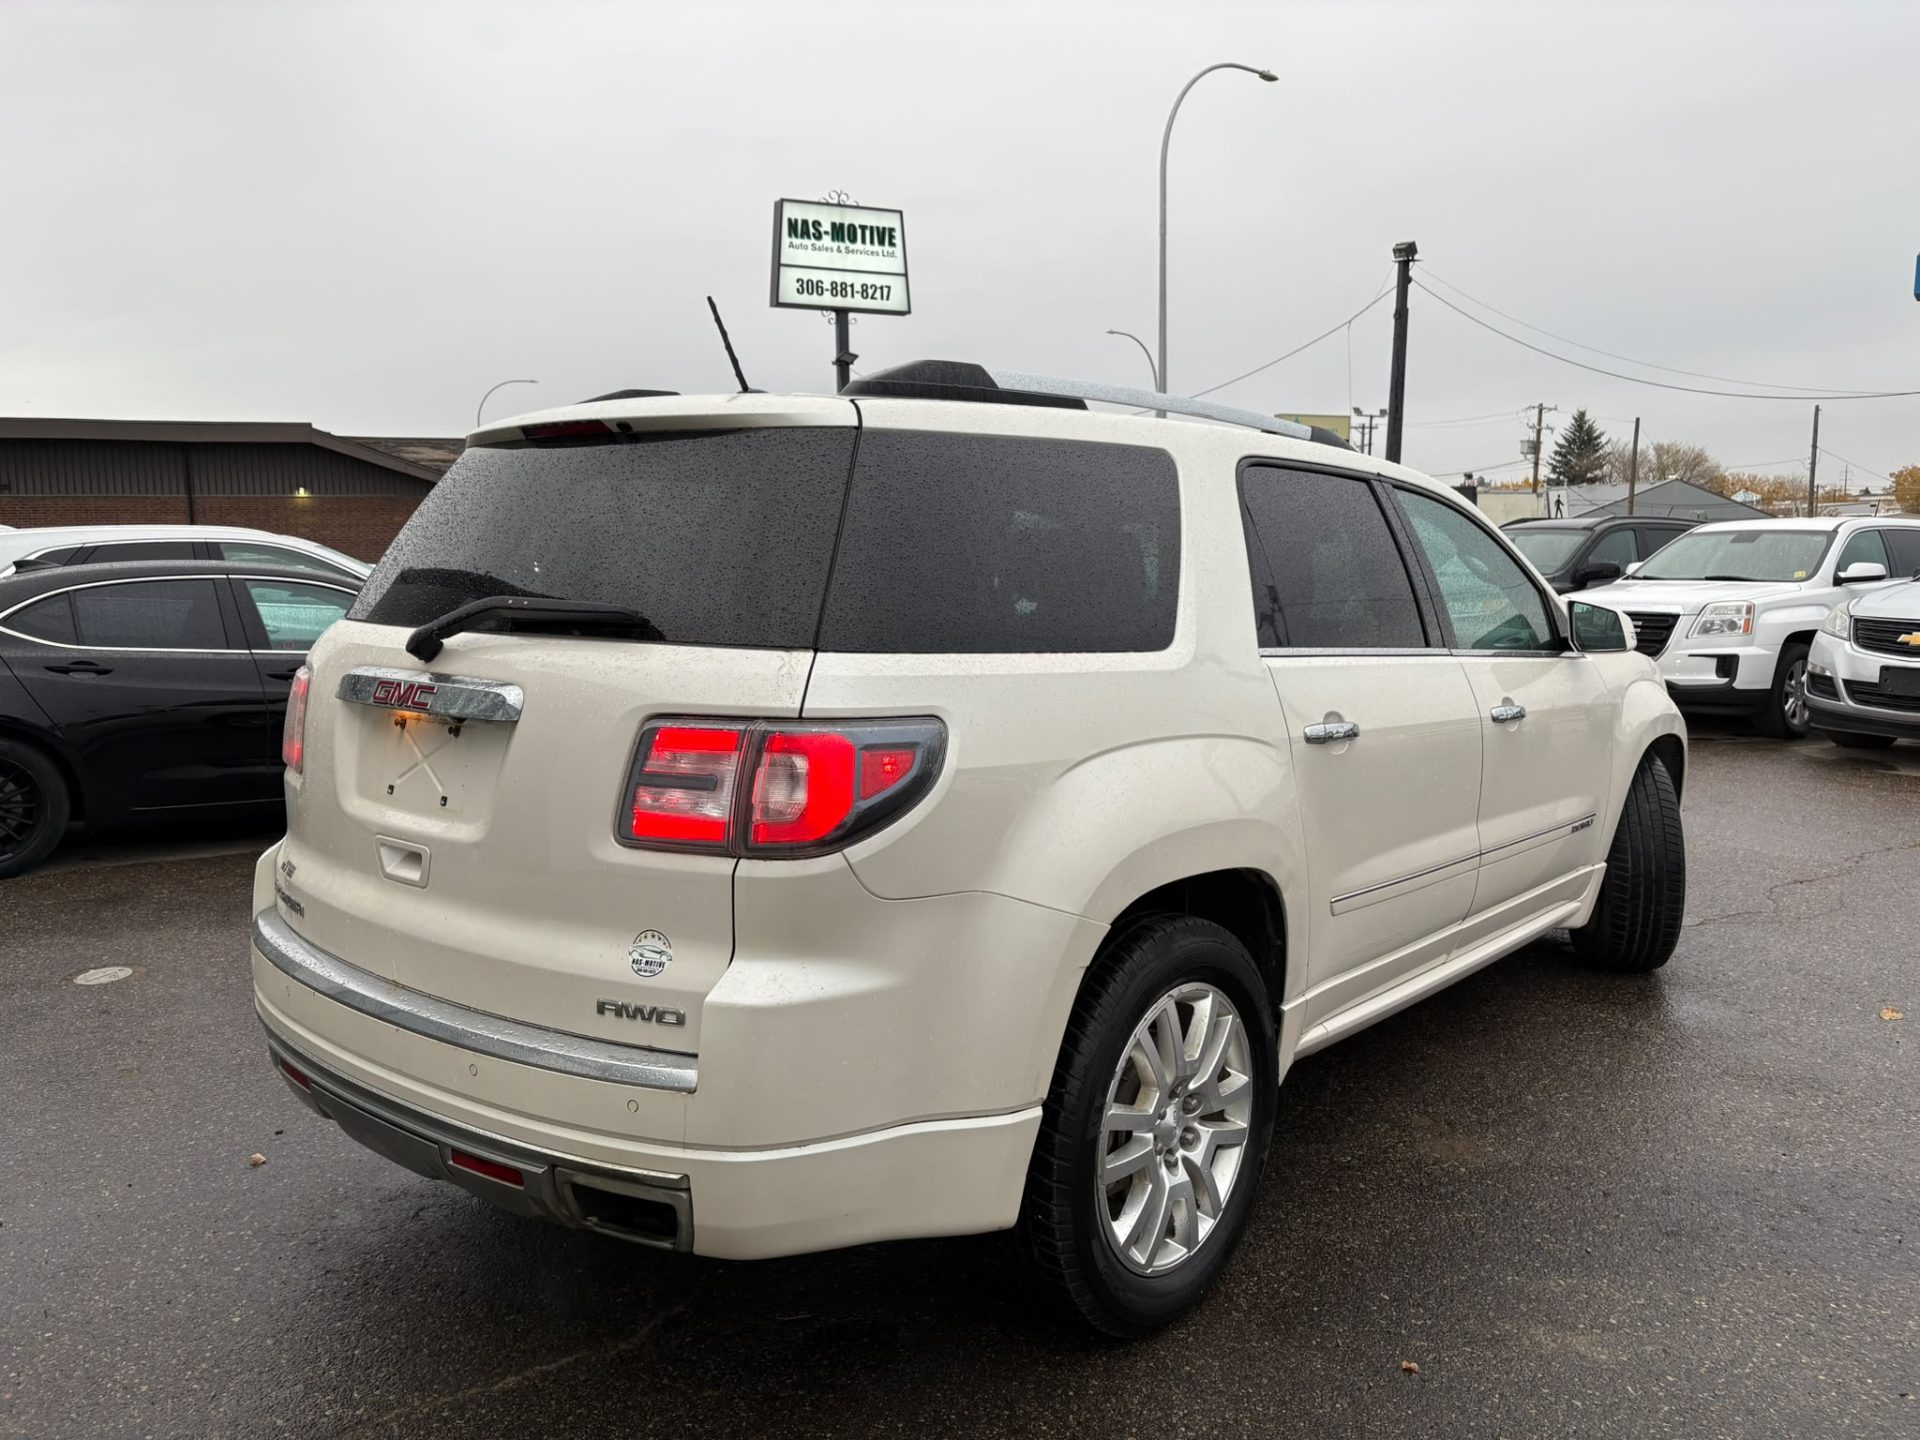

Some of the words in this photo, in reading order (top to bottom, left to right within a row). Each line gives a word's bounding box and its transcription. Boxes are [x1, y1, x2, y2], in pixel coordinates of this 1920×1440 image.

[787, 217, 897, 248] NAS-MOTIVE
[788, 241, 809, 251] Auto
[811, 243, 834, 253] Sales
[837, 246, 843, 254] &
[844, 246, 880, 257] Services
[881, 249, 898, 258] Ltd.
[796, 278, 892, 301] 306-881-8217
[372, 680, 438, 710] GMC
[596, 999, 686, 1028] AWD
